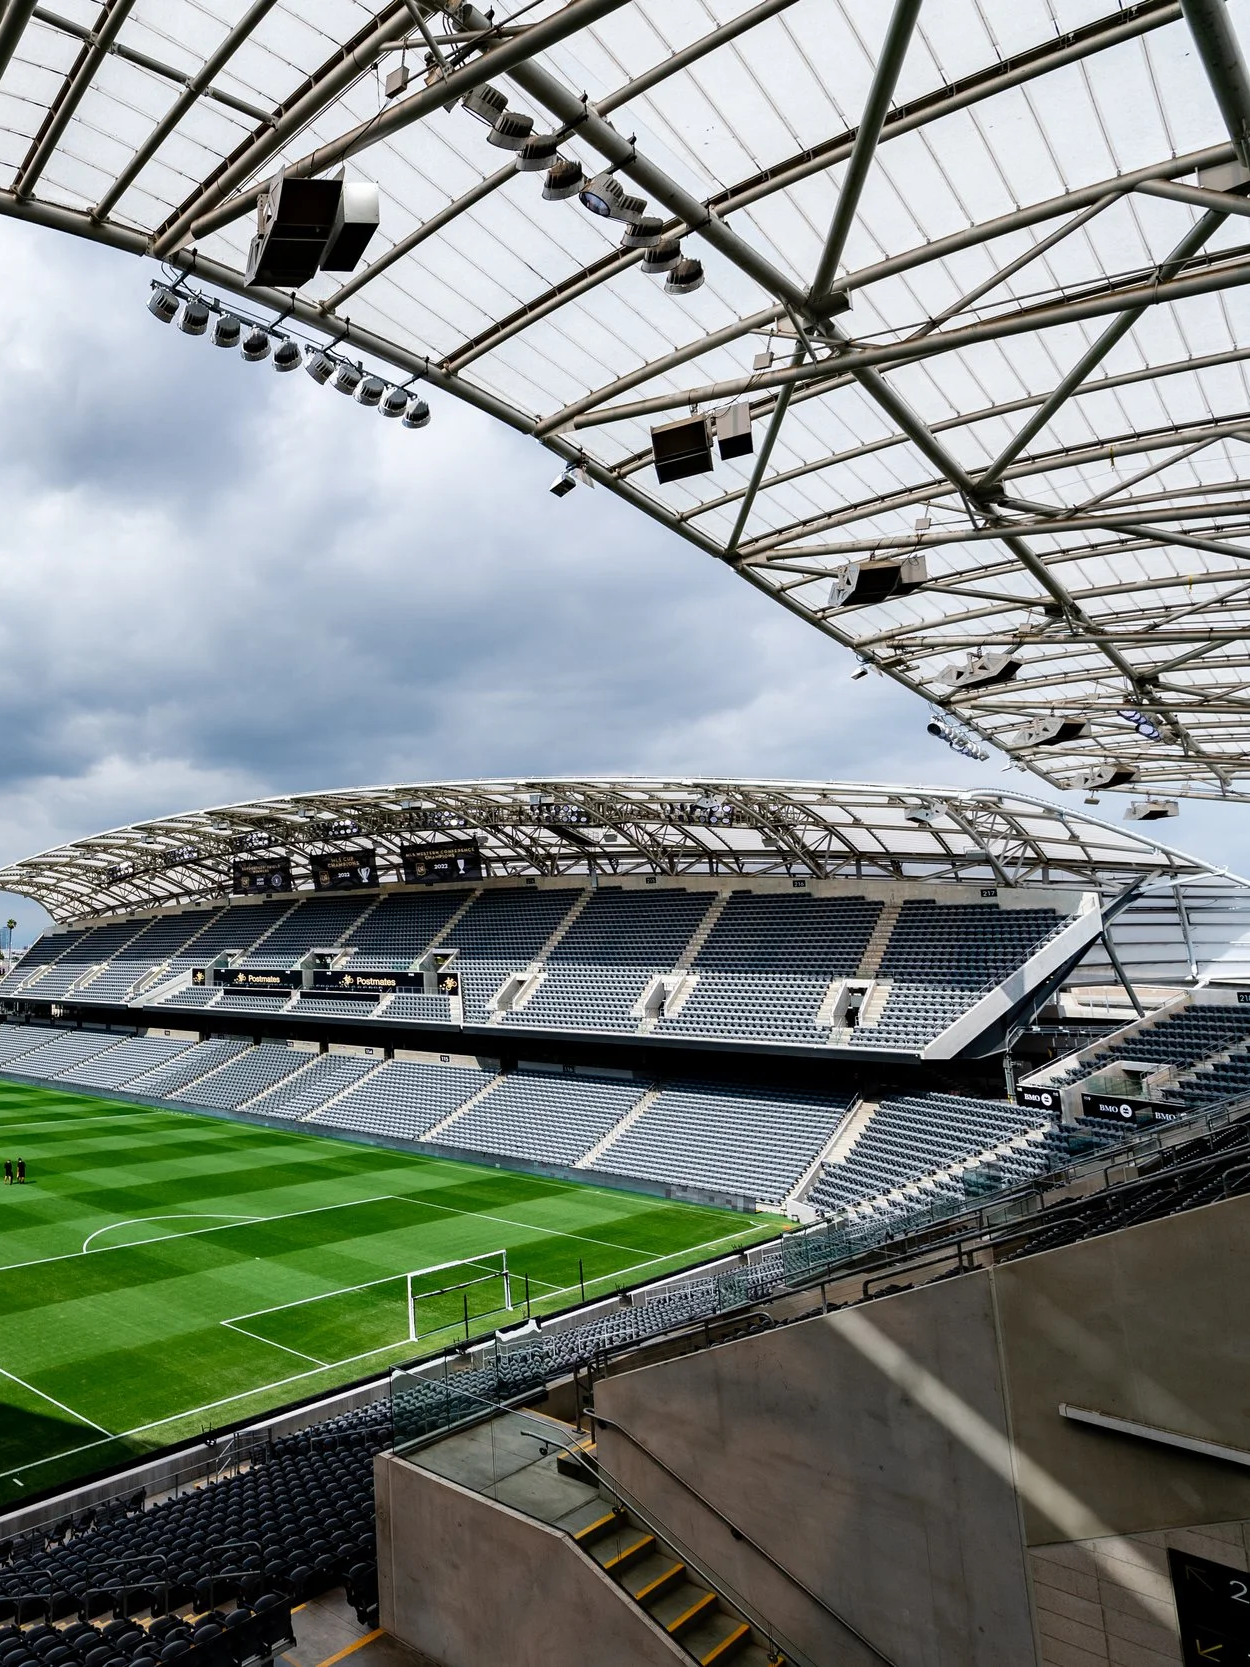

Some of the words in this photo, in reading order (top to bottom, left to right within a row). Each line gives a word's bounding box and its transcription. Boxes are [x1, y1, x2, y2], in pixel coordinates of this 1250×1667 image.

[248, 974, 280, 983] Postmates
[356, 977, 396, 986] Postmates
[1024, 1093, 1040, 1101] BMO
[1099, 1104, 1118, 1113] BMO
[1155, 1112, 1176, 1121] BMO
